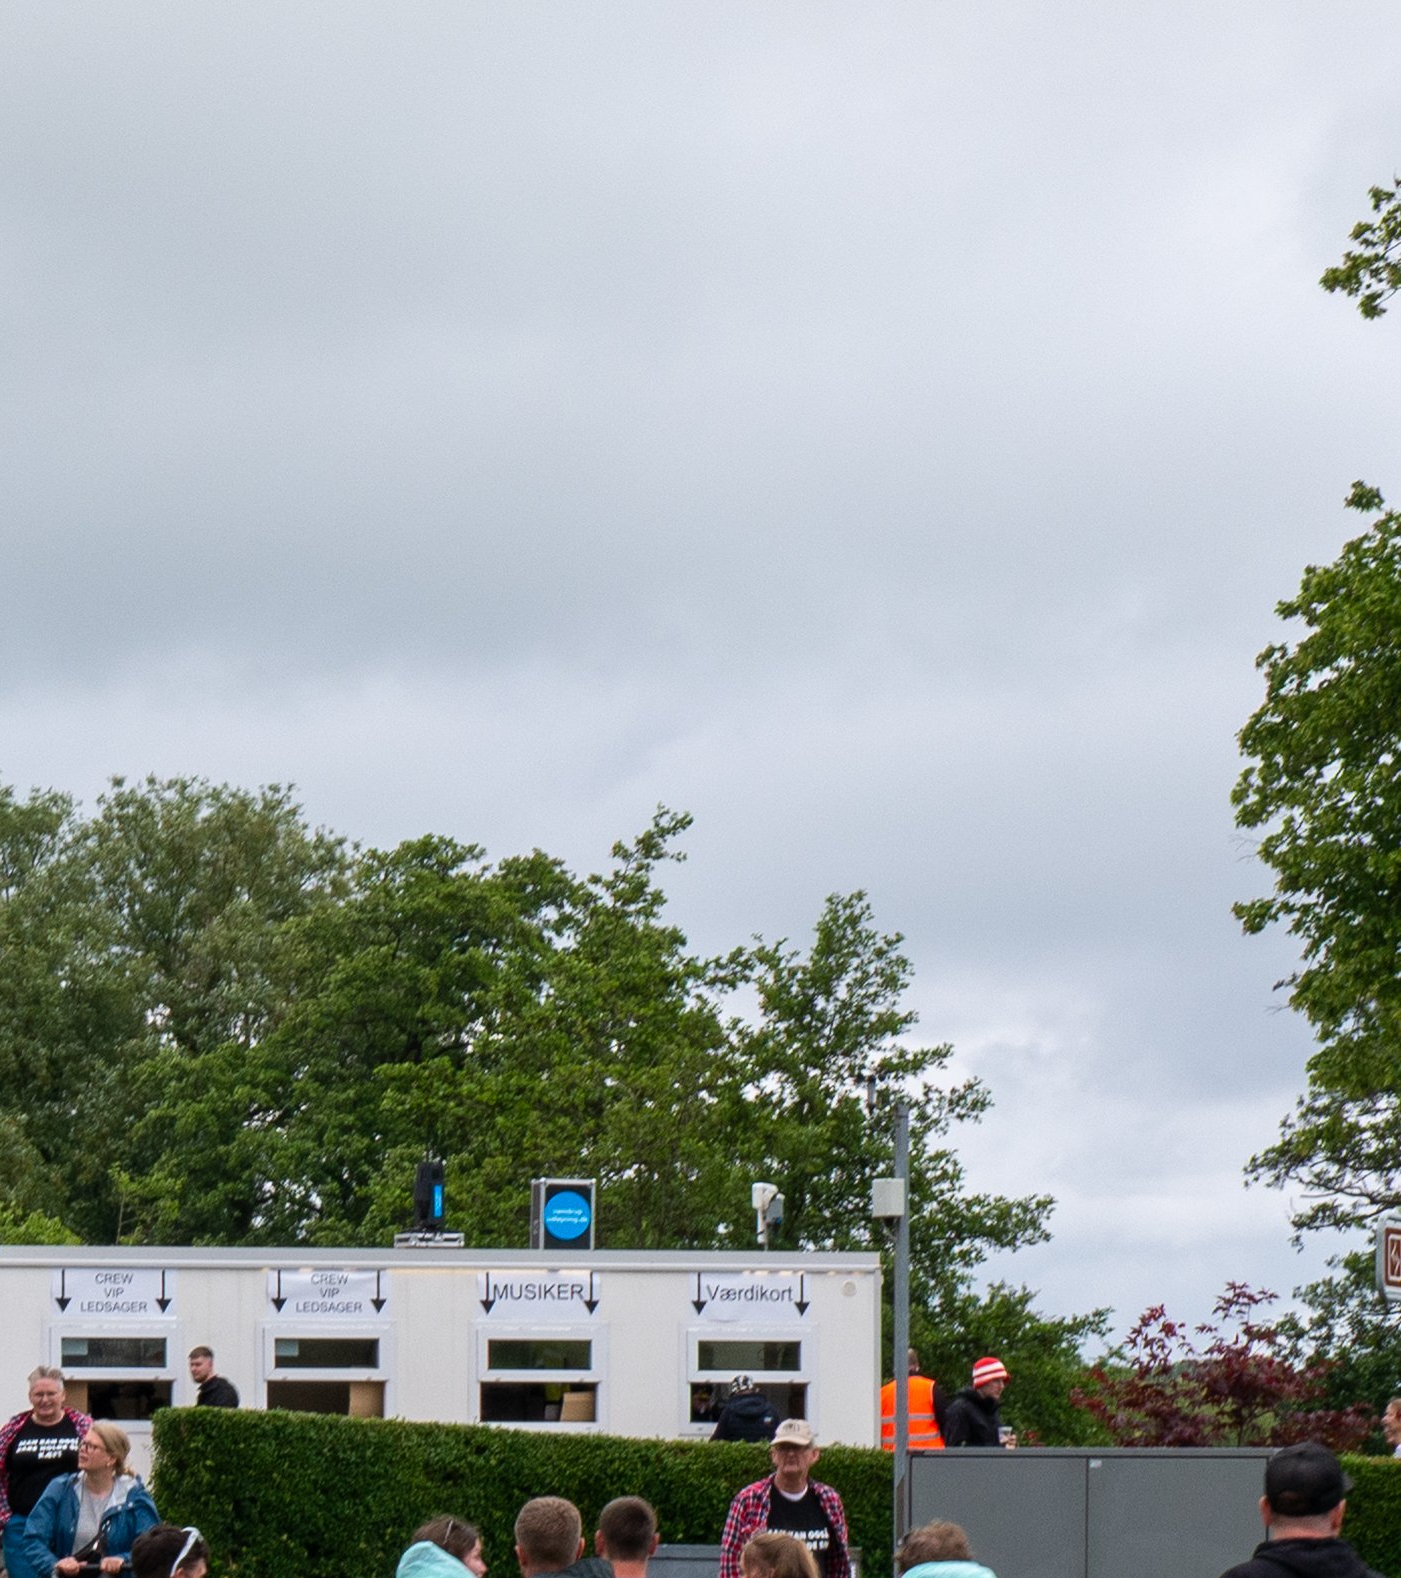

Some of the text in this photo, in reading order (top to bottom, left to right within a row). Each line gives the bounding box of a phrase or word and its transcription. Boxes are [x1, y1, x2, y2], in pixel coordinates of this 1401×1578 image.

[94, 1272, 134, 1285] CREW
[310, 1273, 349, 1286] CREW
[104, 1287, 125, 1299] VIP
[319, 1287, 340, 1299] VIP
[493, 1283, 585, 1301] MUSIKER
[706, 1284, 794, 1301] Værdikort
[80, 1301, 148, 1313] LEDSAGER
[295, 1301, 363, 1313] LEDSAGER
